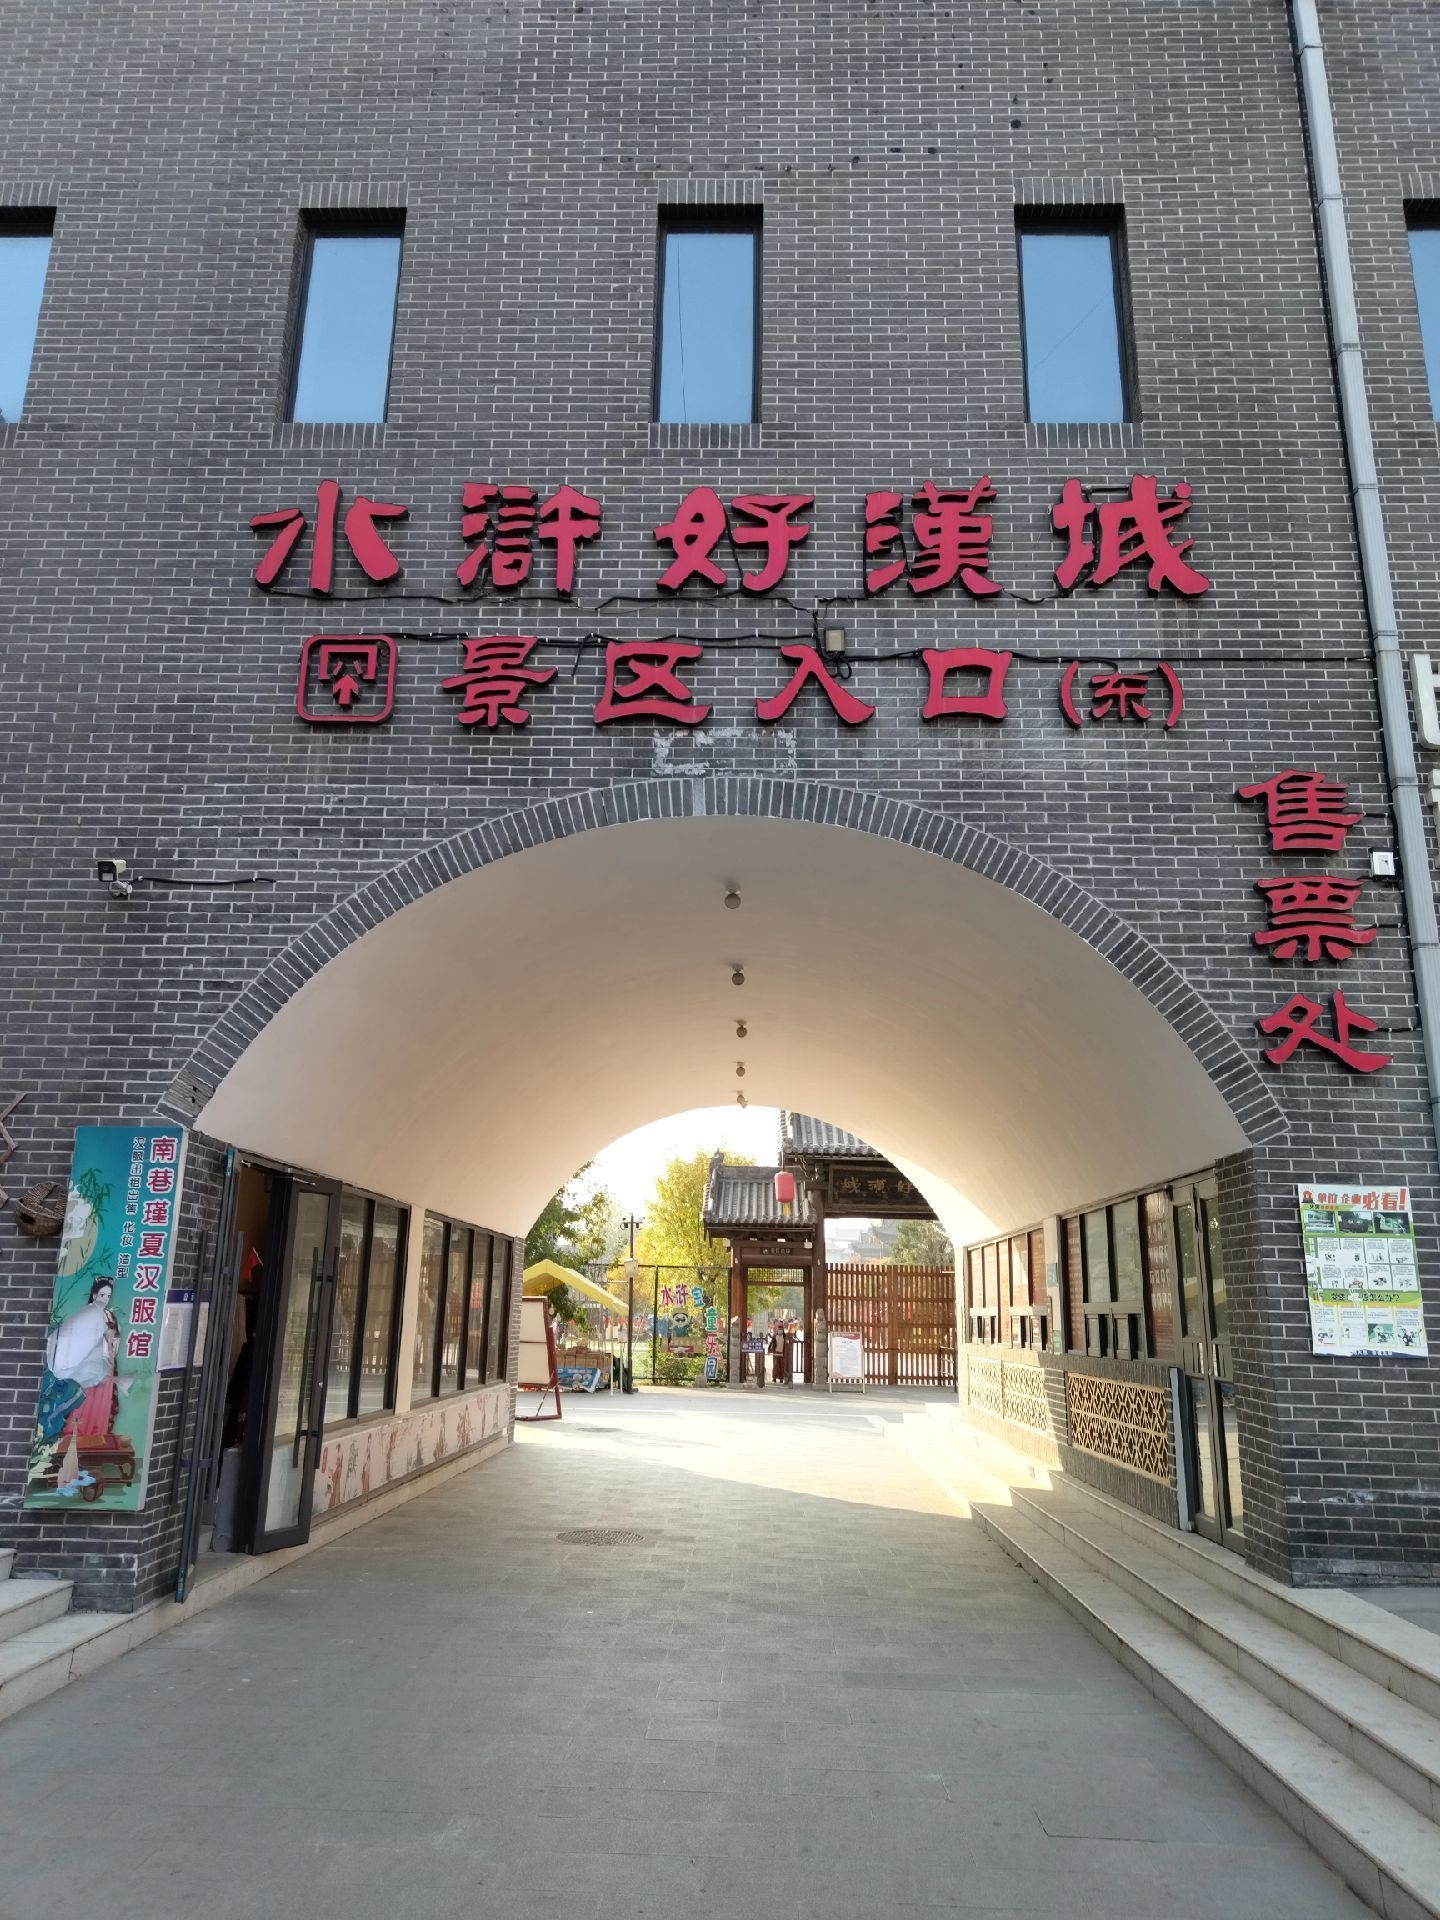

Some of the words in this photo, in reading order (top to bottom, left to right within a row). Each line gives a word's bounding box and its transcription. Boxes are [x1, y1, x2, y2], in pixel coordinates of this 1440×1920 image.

[1235, 768, 1394, 1073] 售票处
[126, 1136, 145, 1215] 汉服出租出售
[116, 1253, 131, 1279] 造型
[121, 1221, 136, 1247] 化妆
[126, 1136, 176, 1358] 南巷瑾夏汉服馆
